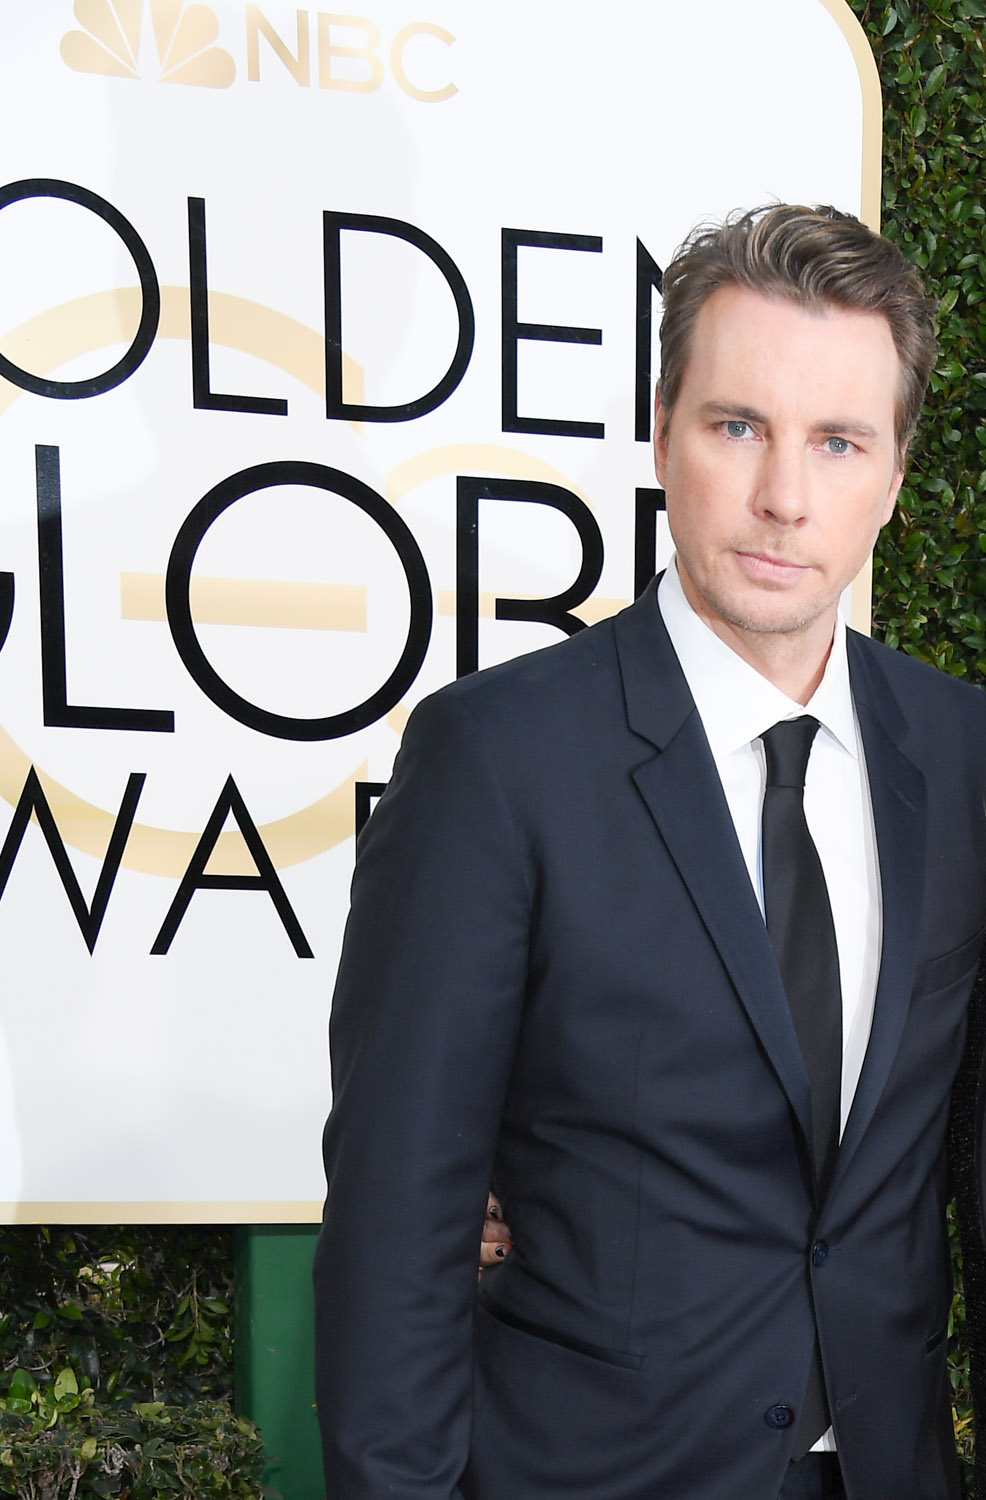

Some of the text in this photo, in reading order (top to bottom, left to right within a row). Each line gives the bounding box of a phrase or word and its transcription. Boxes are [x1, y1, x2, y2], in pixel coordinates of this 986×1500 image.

[245, 3, 459, 103] NBC
[0, 178, 664, 442] OLDE
[0, 444, 669, 742] LOB
